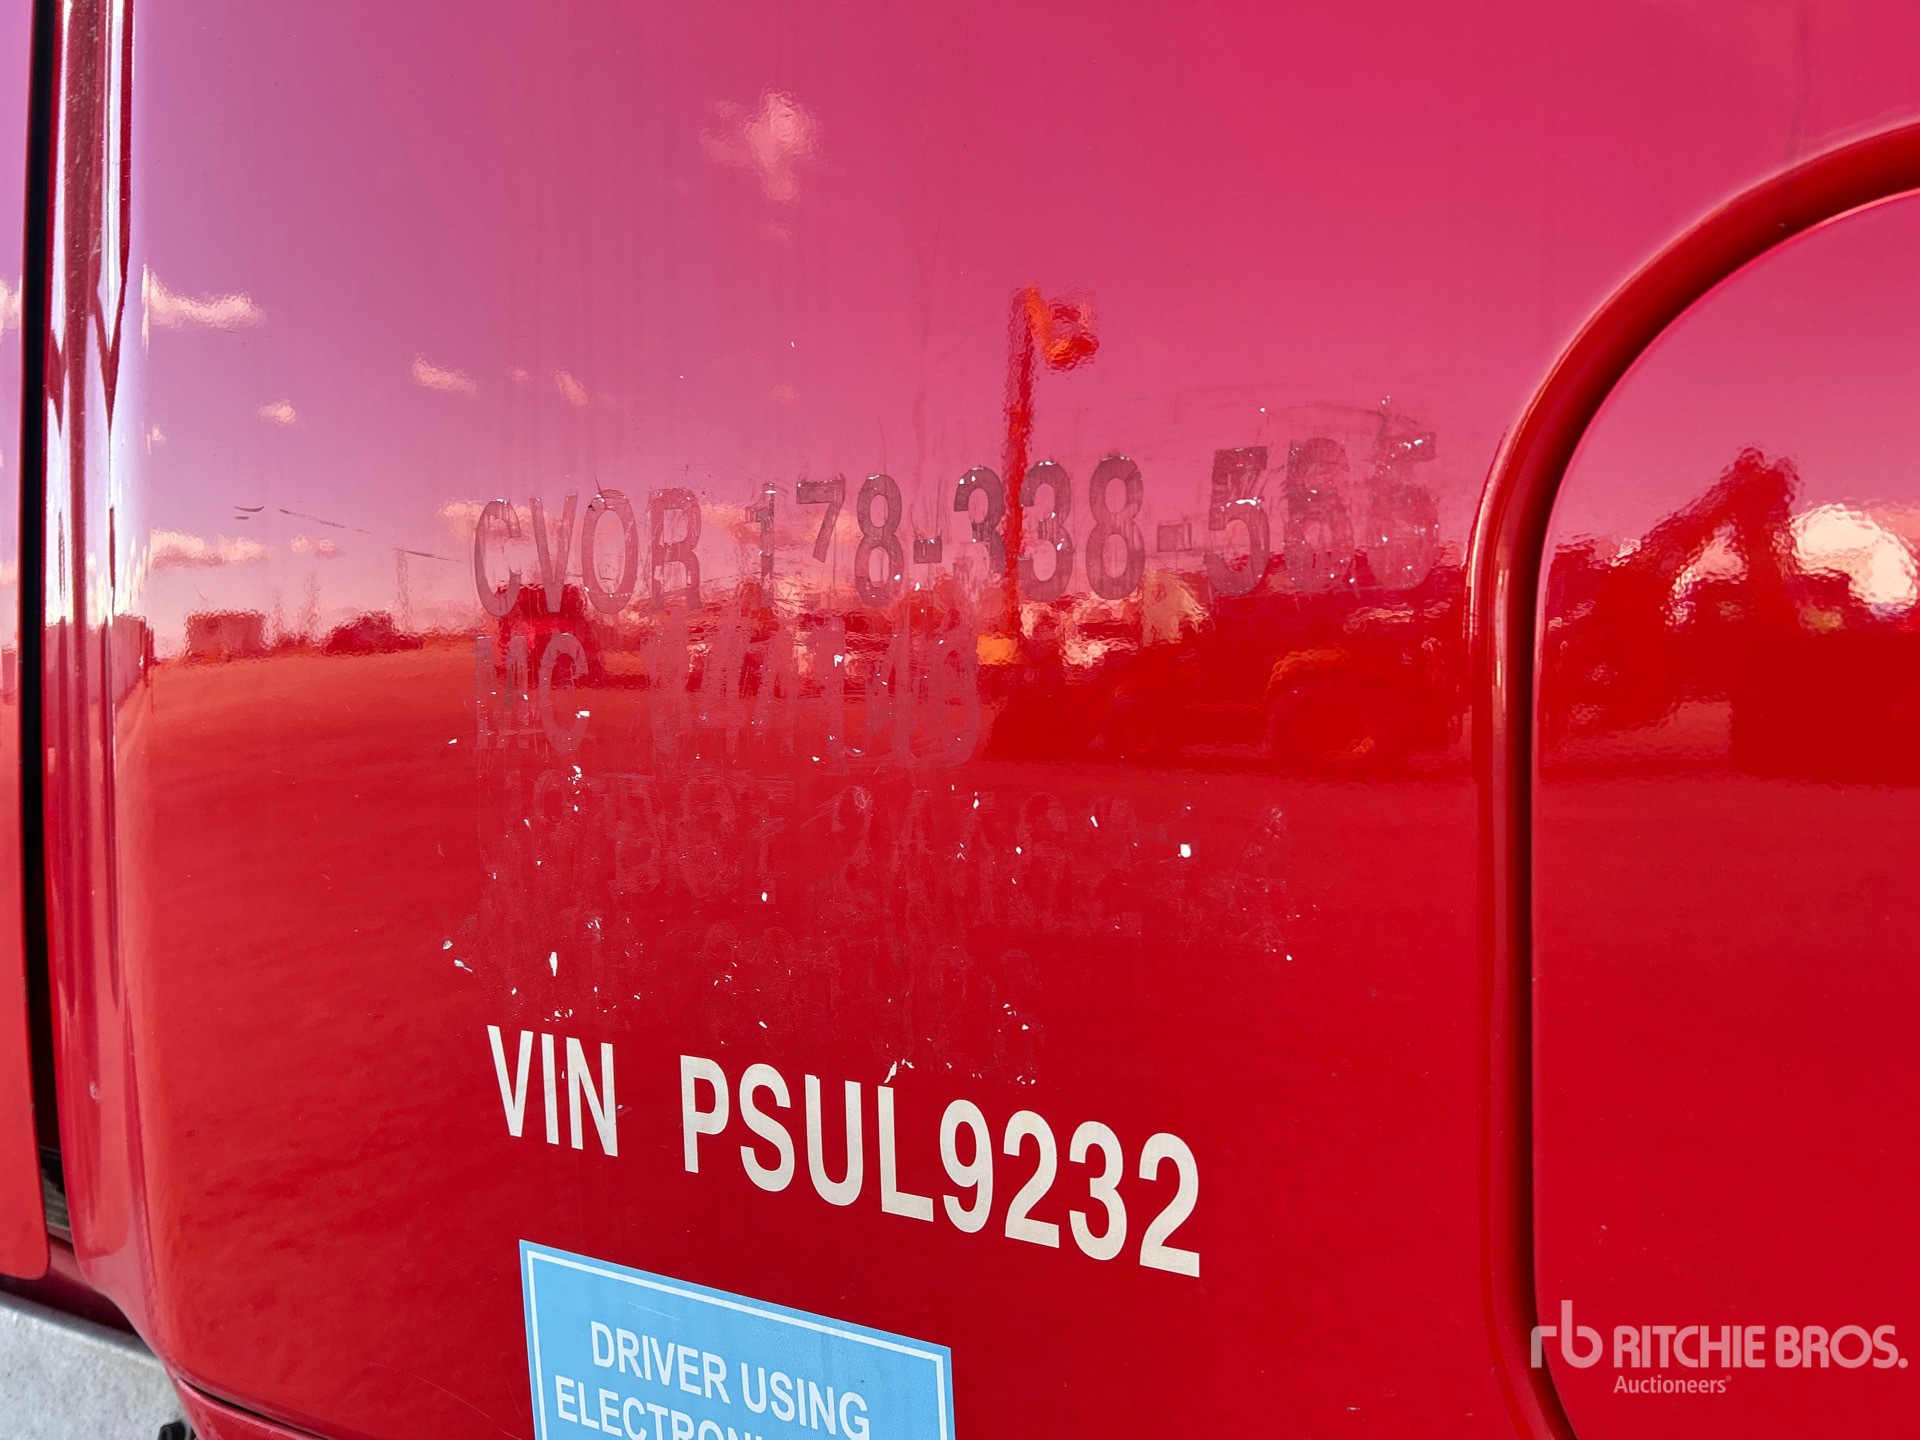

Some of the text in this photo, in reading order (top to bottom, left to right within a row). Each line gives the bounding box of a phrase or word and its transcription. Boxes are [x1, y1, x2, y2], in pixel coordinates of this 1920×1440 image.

[474, 488, 700, 616] CVOR
[488, 1025, 1201, 1278] VIN PSUL9232
[555, 1375, 763, 1440] ELECTR
[591, 1321, 870, 1440] DRIVER USING
